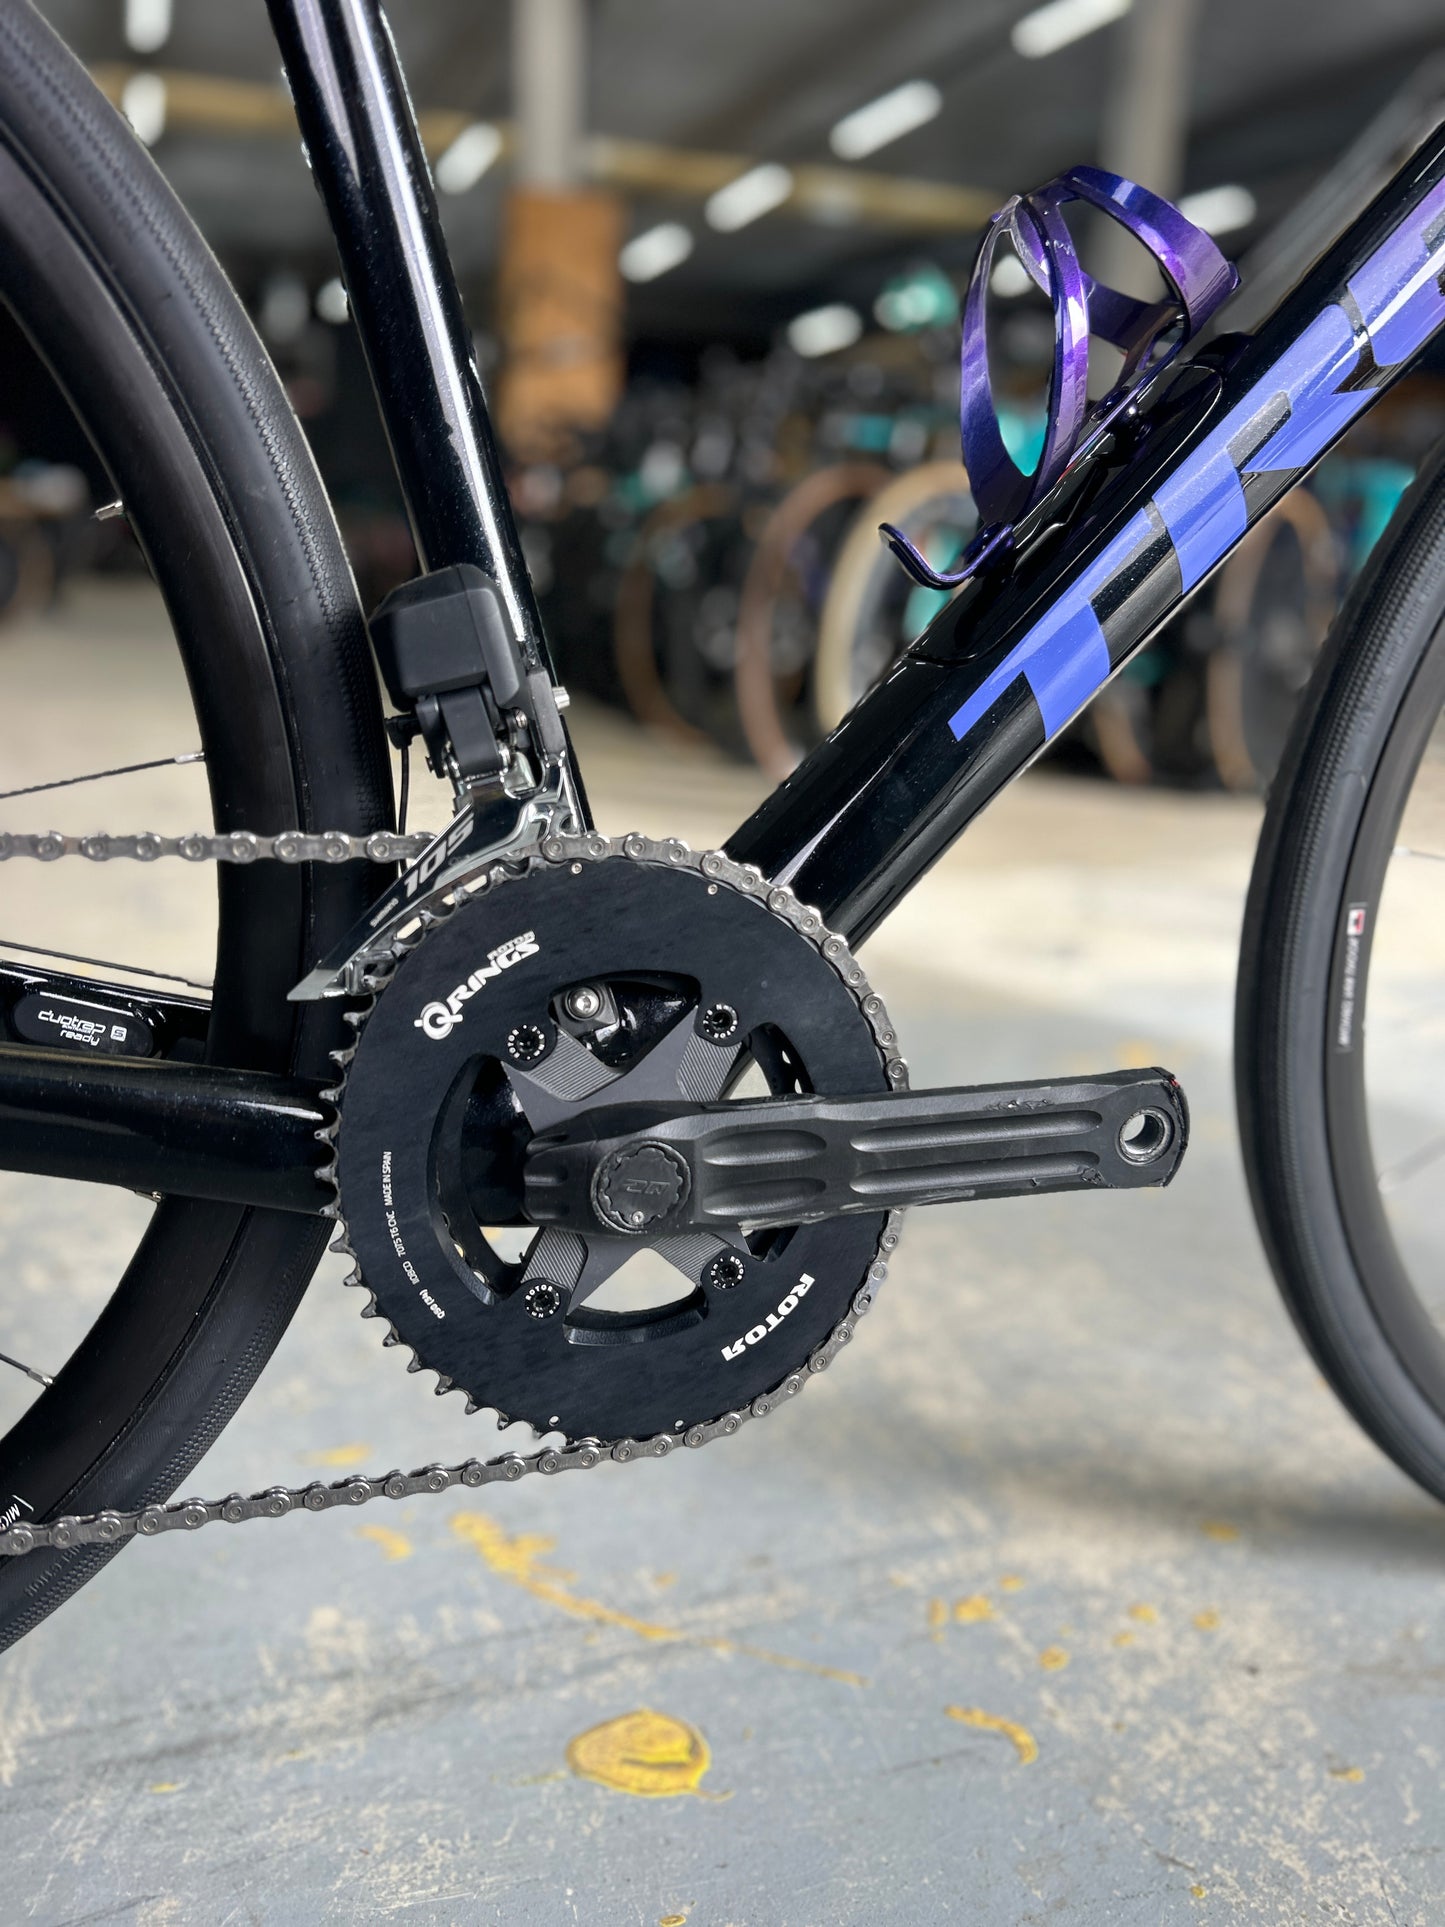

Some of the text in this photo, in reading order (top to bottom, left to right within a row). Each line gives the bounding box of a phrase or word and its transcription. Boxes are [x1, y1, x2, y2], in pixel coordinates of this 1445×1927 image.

[404, 812, 475, 898] 105
[38, 1010, 106, 1035] duotrap
[60, 1030, 100, 1046] ready
[382, 1151, 392, 1173] SPAIN
[382, 1183, 393, 1206] MADE
[721, 1273, 816, 1361] ROTOR
